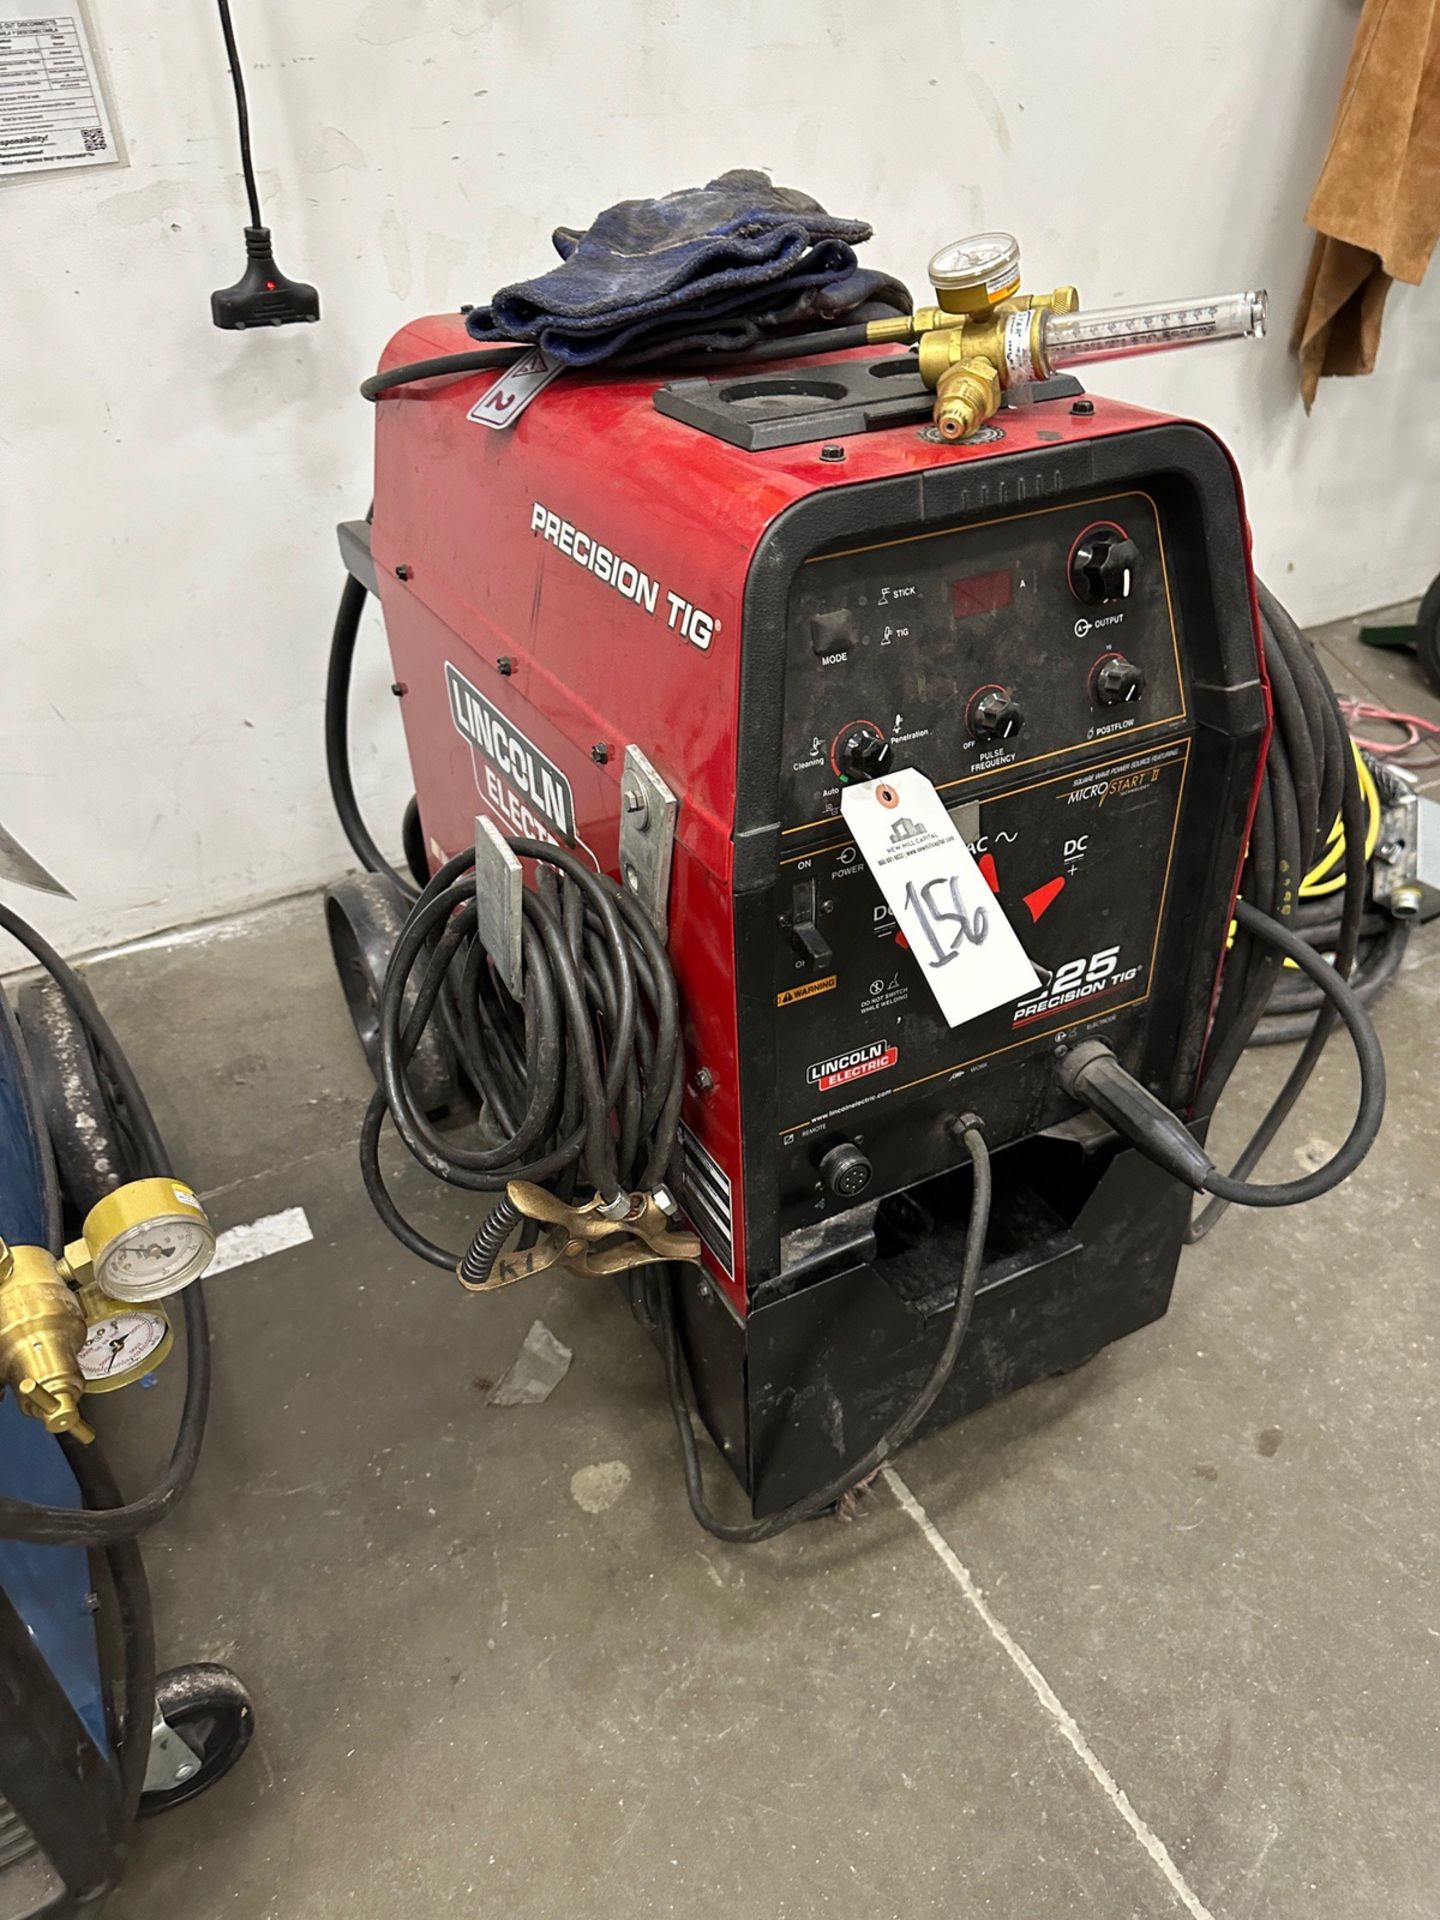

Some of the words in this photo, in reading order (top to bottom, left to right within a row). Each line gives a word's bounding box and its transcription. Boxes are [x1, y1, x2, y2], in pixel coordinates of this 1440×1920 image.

[485, 390, 515, 411] 2
[531, 502, 659, 614] PRECISION
[893, 586, 916, 599] STICK
[1095, 614, 1123, 629] OUTPUT
[896, 628, 909, 637] TIG
[822, 652, 848, 666] MODE
[1096, 719, 1135, 736] POSTFLOW
[890, 729, 928, 744] Penetration
[963, 740, 976, 750] OFF
[452, 679, 568, 836] LINCOLN
[979, 747, 1004, 761] PULSE
[793, 757, 825, 771] Cleaning
[970, 753, 1016, 773] FREQUENCY
[823, 787, 839, 797] Auto
[1064, 835, 1088, 856] DC
[797, 859, 812, 870] ON
[831, 863, 864, 880] POWER
[904, 875, 989, 968] 156
[1017, 945, 1120, 1008] 25
[793, 979, 835, 998] WARNING
[860, 1000, 871, 1008] DO
[871, 995, 884, 1004] NOT
[884, 987, 908, 1000] SWITCH
[1013, 979, 1106, 1021] PRECISION
[811, 1044, 882, 1080] LINCOLN
[828, 1056, 889, 1086] ELECTRIC
[802, 1123, 827, 1136] REMOTE
